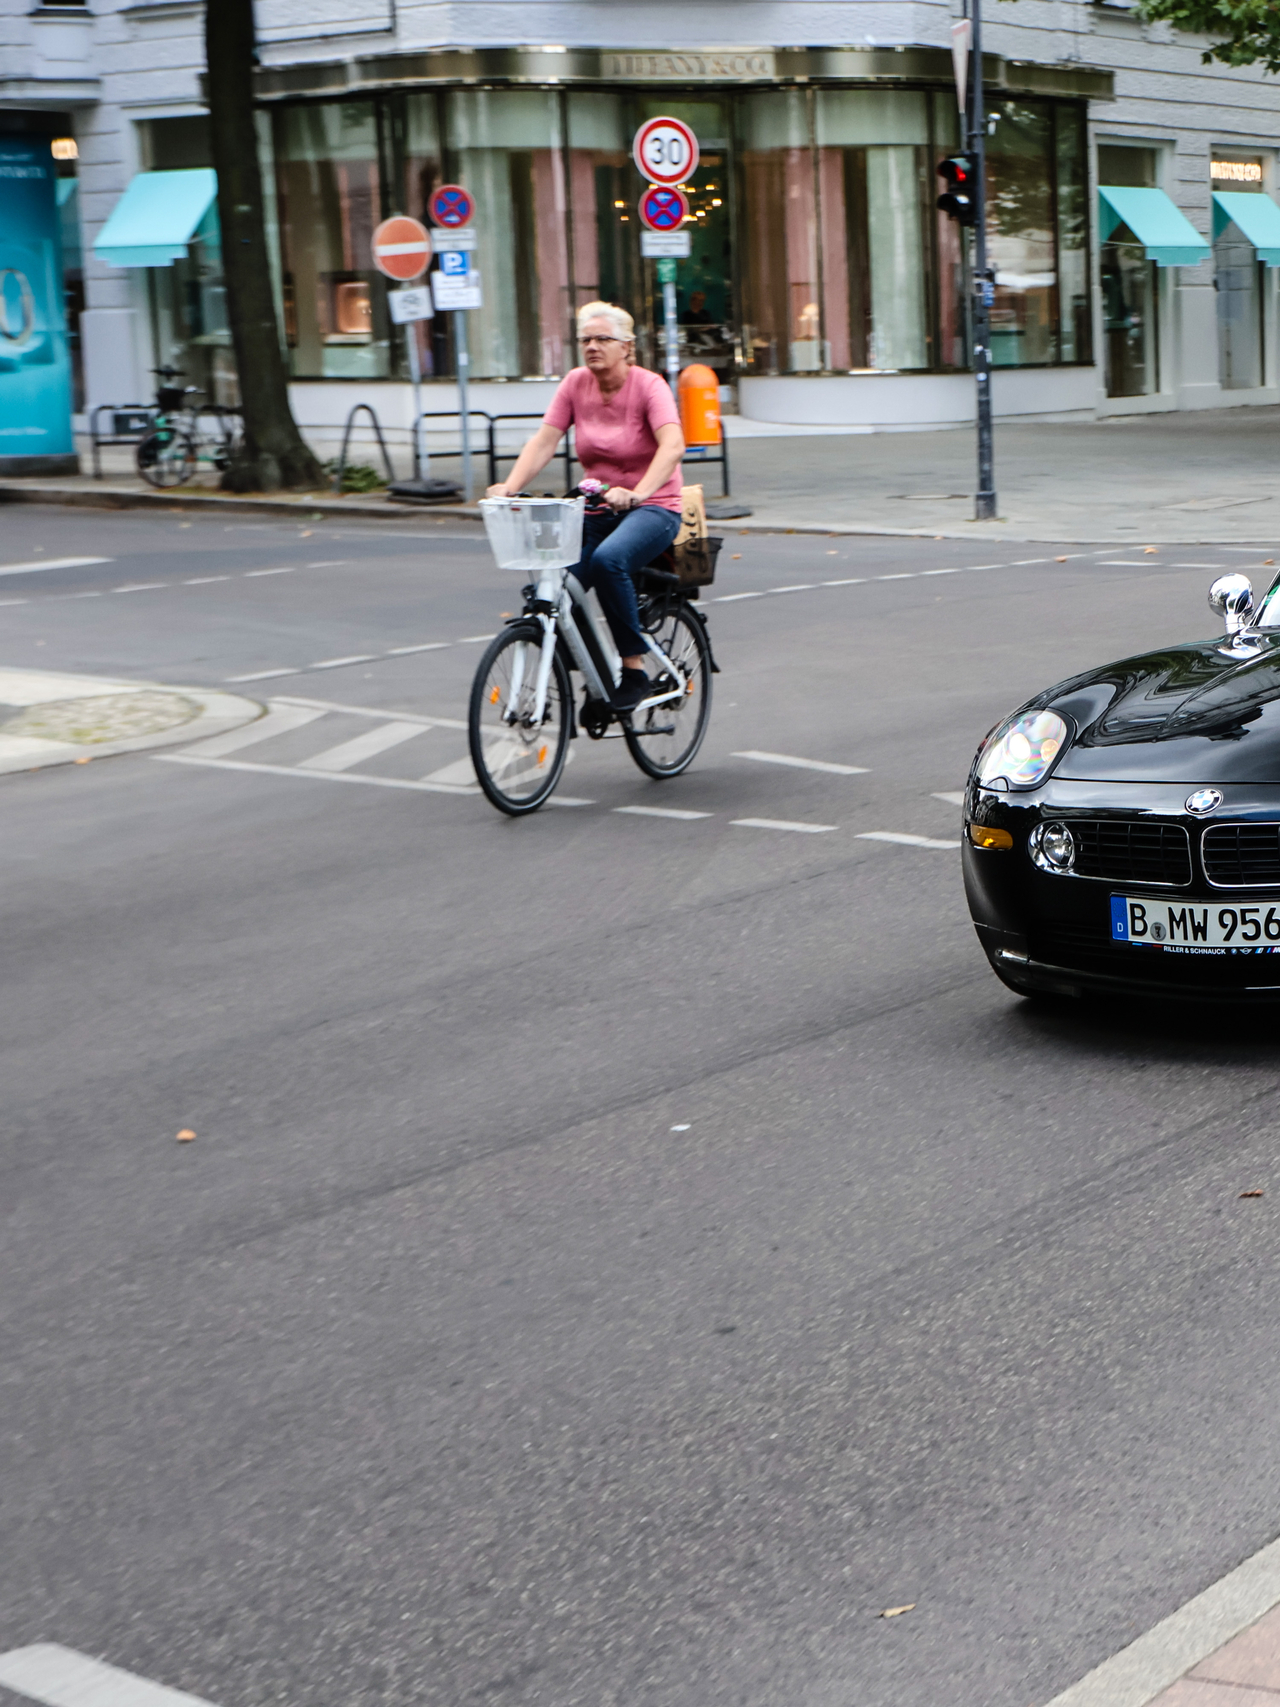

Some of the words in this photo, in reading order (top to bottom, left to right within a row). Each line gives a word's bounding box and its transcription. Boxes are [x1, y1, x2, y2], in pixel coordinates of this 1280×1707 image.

[650, 137, 682, 165] 30
[1117, 922, 1124, 932] D
[1129, 903, 1148, 936] B
[1168, 906, 1208, 941] MW
[1163, 945, 1184, 953] RILLER
